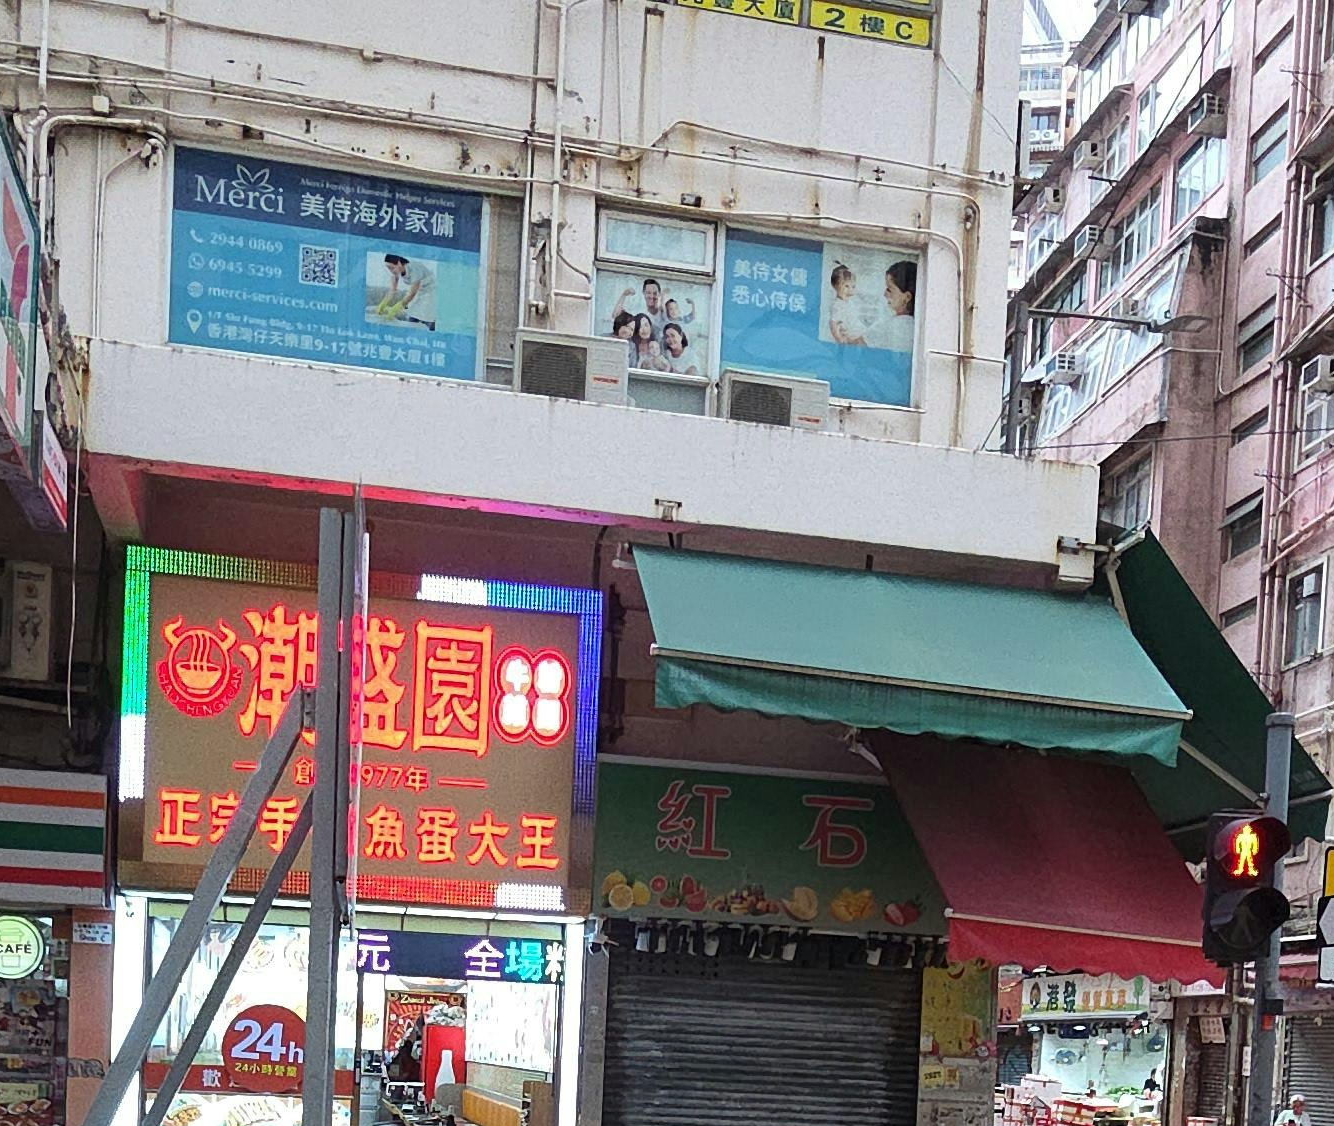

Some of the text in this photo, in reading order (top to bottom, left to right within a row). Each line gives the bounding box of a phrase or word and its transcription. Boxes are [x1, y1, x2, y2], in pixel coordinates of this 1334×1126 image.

[683, 0, 795, 21] 大廈
[194, 173, 286, 215] Merci
[299, 191, 455, 239] 美侍海外家傭
[209, 232, 284, 254] 2944 0869
[208, 257, 283, 279] 6945 5299
[733, 258, 808, 288] 美侍女傭
[207, 285, 339, 313] merci-services.com
[236, 603, 495, 758] 潮盛園
[154, 789, 562, 871] 正宗手魚蛋大王
[656, 778, 874, 869] 紅石
